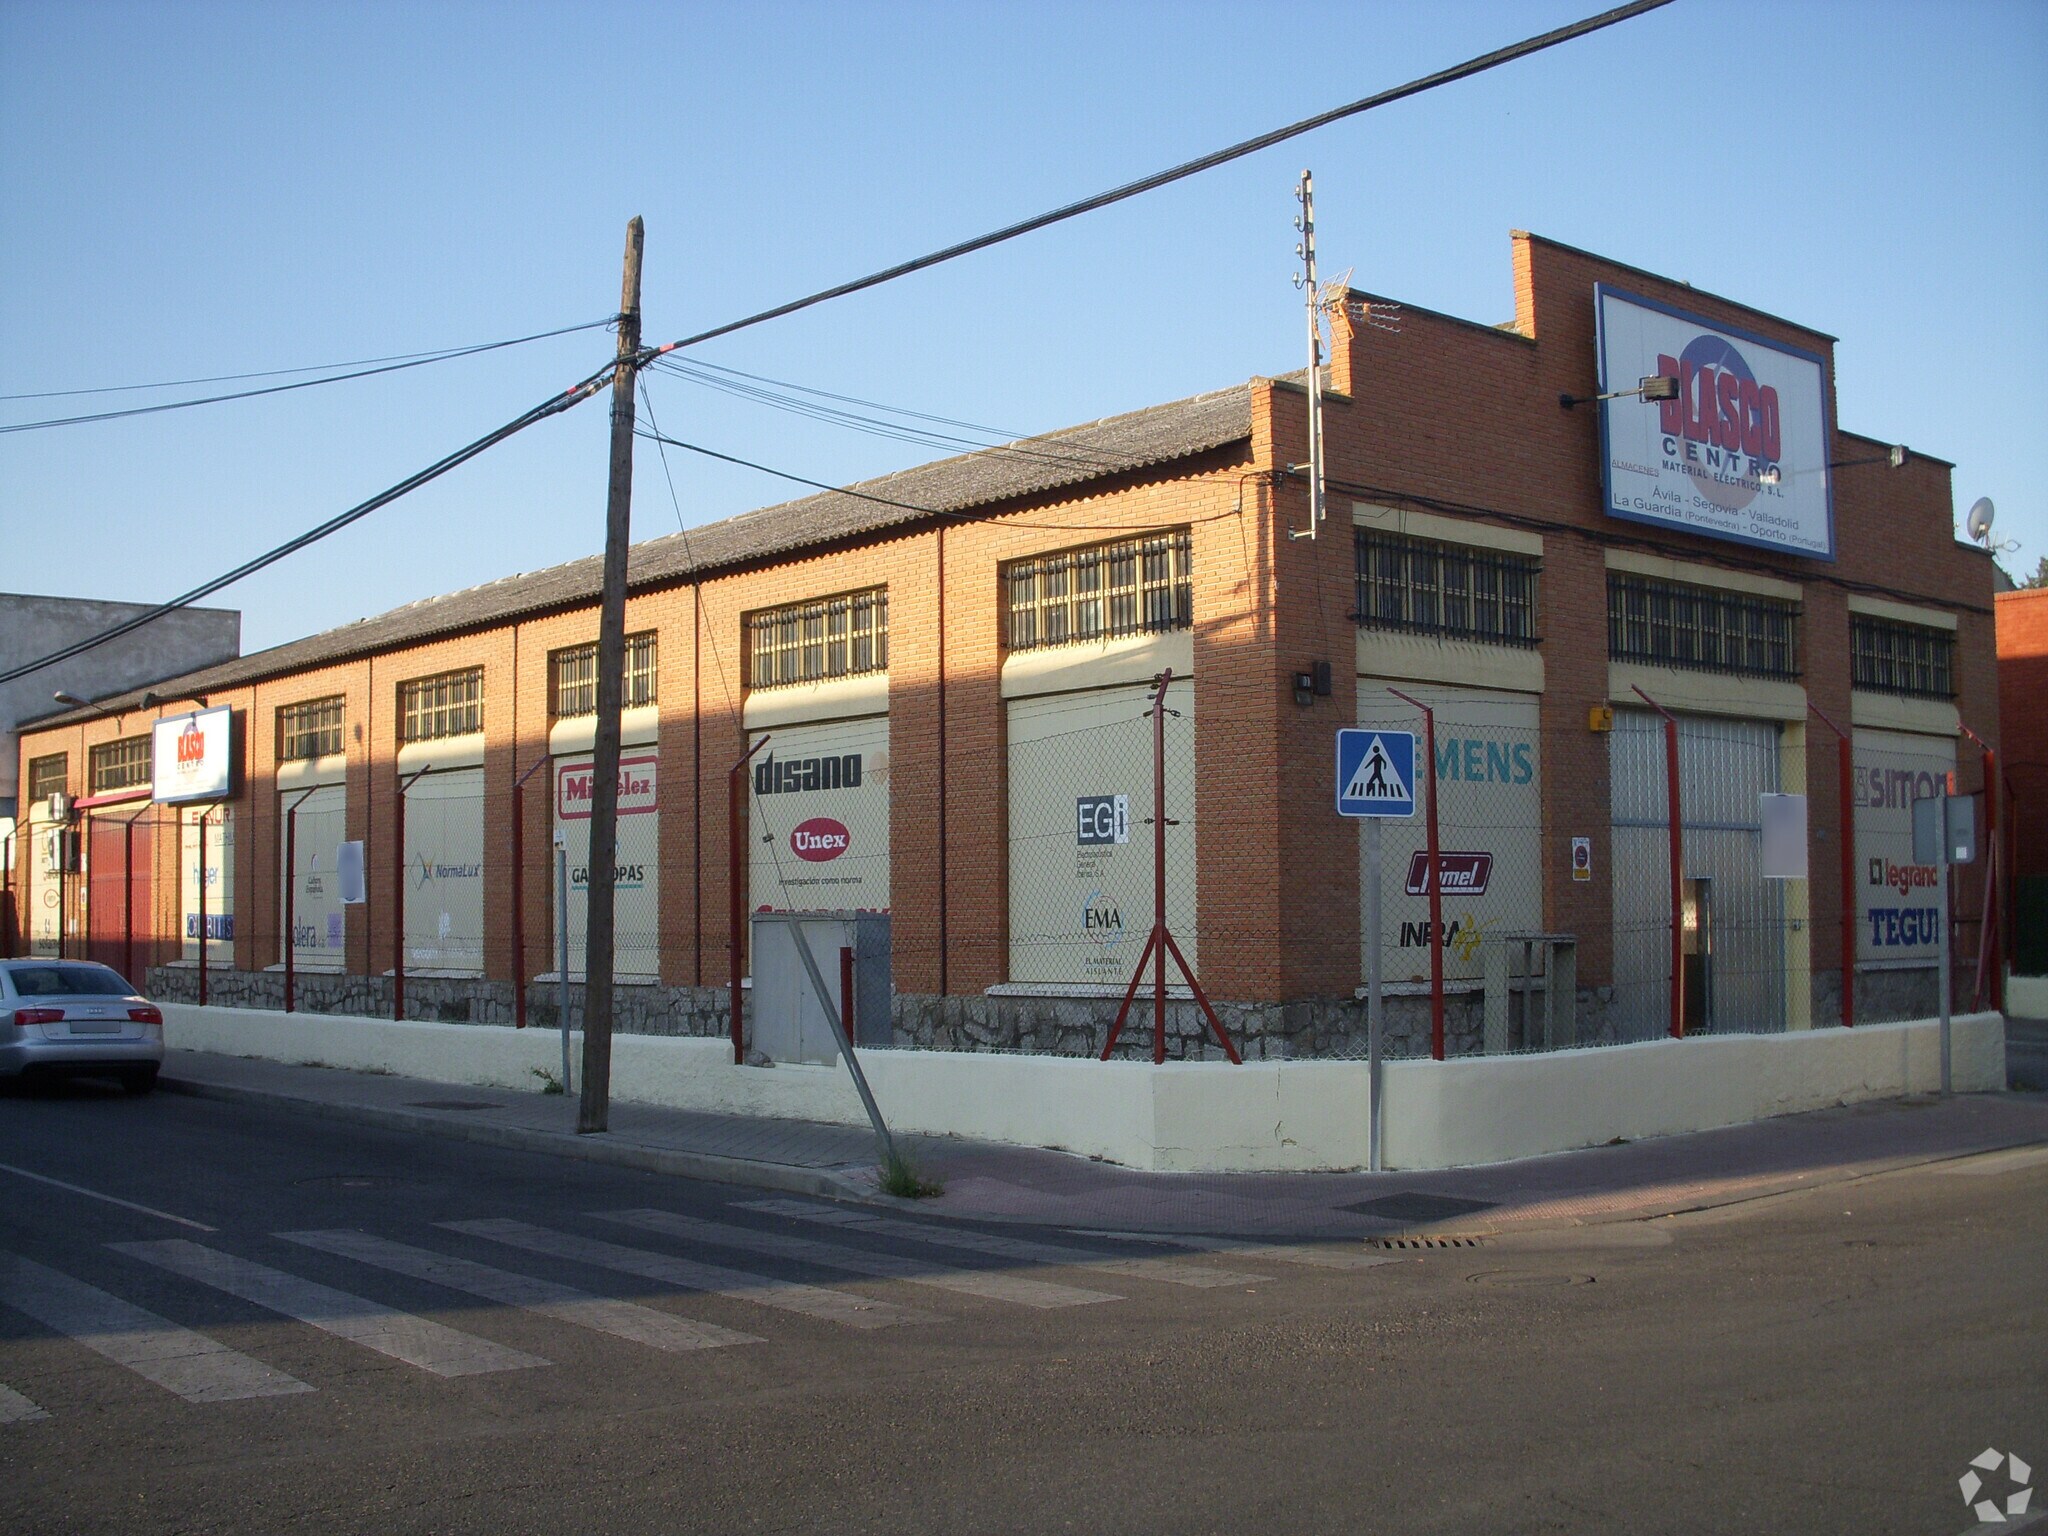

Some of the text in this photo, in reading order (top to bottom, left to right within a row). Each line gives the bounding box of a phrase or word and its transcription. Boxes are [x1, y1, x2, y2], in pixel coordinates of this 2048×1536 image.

[1657, 353, 1781, 463] BLASCO
[1611, 459, 1660, 478] ALMACENES
[1662, 437, 1782, 484] CENTRO
[1662, 459, 1708, 479] MATERIAL
[1613, 493, 1630, 507] La
[1633, 498, 1682, 517] Guardia
[1685, 511, 1741, 531] (Pontevedra)
[1750, 523, 1787, 541] Oporto
[1652, 485, 1681, 503] Ávila
[1693, 496, 1739, 516] Segovia
[1749, 509, 1799, 530] Valladolid
[755, 750, 862, 796] disano
[191, 807, 231, 826] ENUR
[794, 831, 847, 851] Unex
[841, 874, 862, 885] norma
[1084, 908, 1122, 929] EMA
